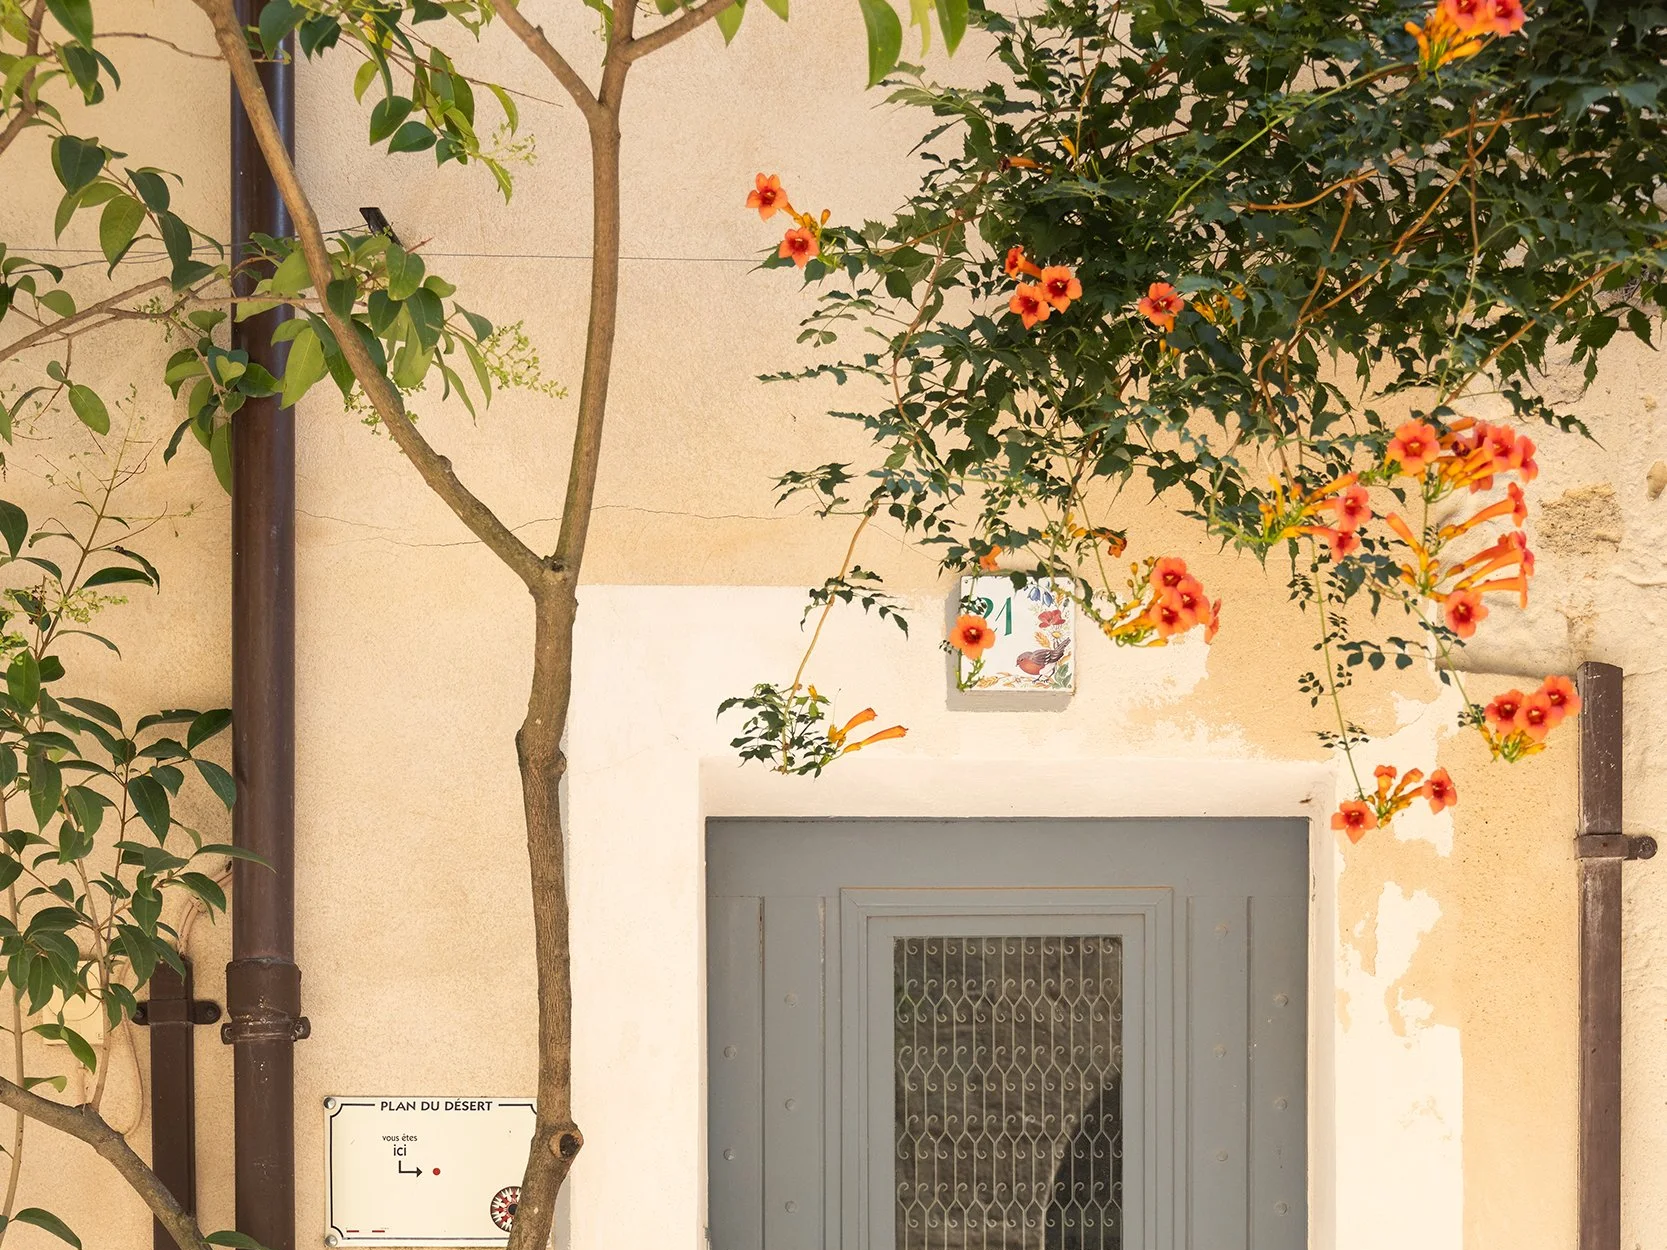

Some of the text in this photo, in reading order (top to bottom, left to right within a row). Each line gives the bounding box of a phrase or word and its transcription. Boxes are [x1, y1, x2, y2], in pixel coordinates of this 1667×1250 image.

[380, 1098, 493, 1112] PLAN DU DÉSERT
[401, 1133, 418, 1142] êtes
[393, 1144, 407, 1157] ici
